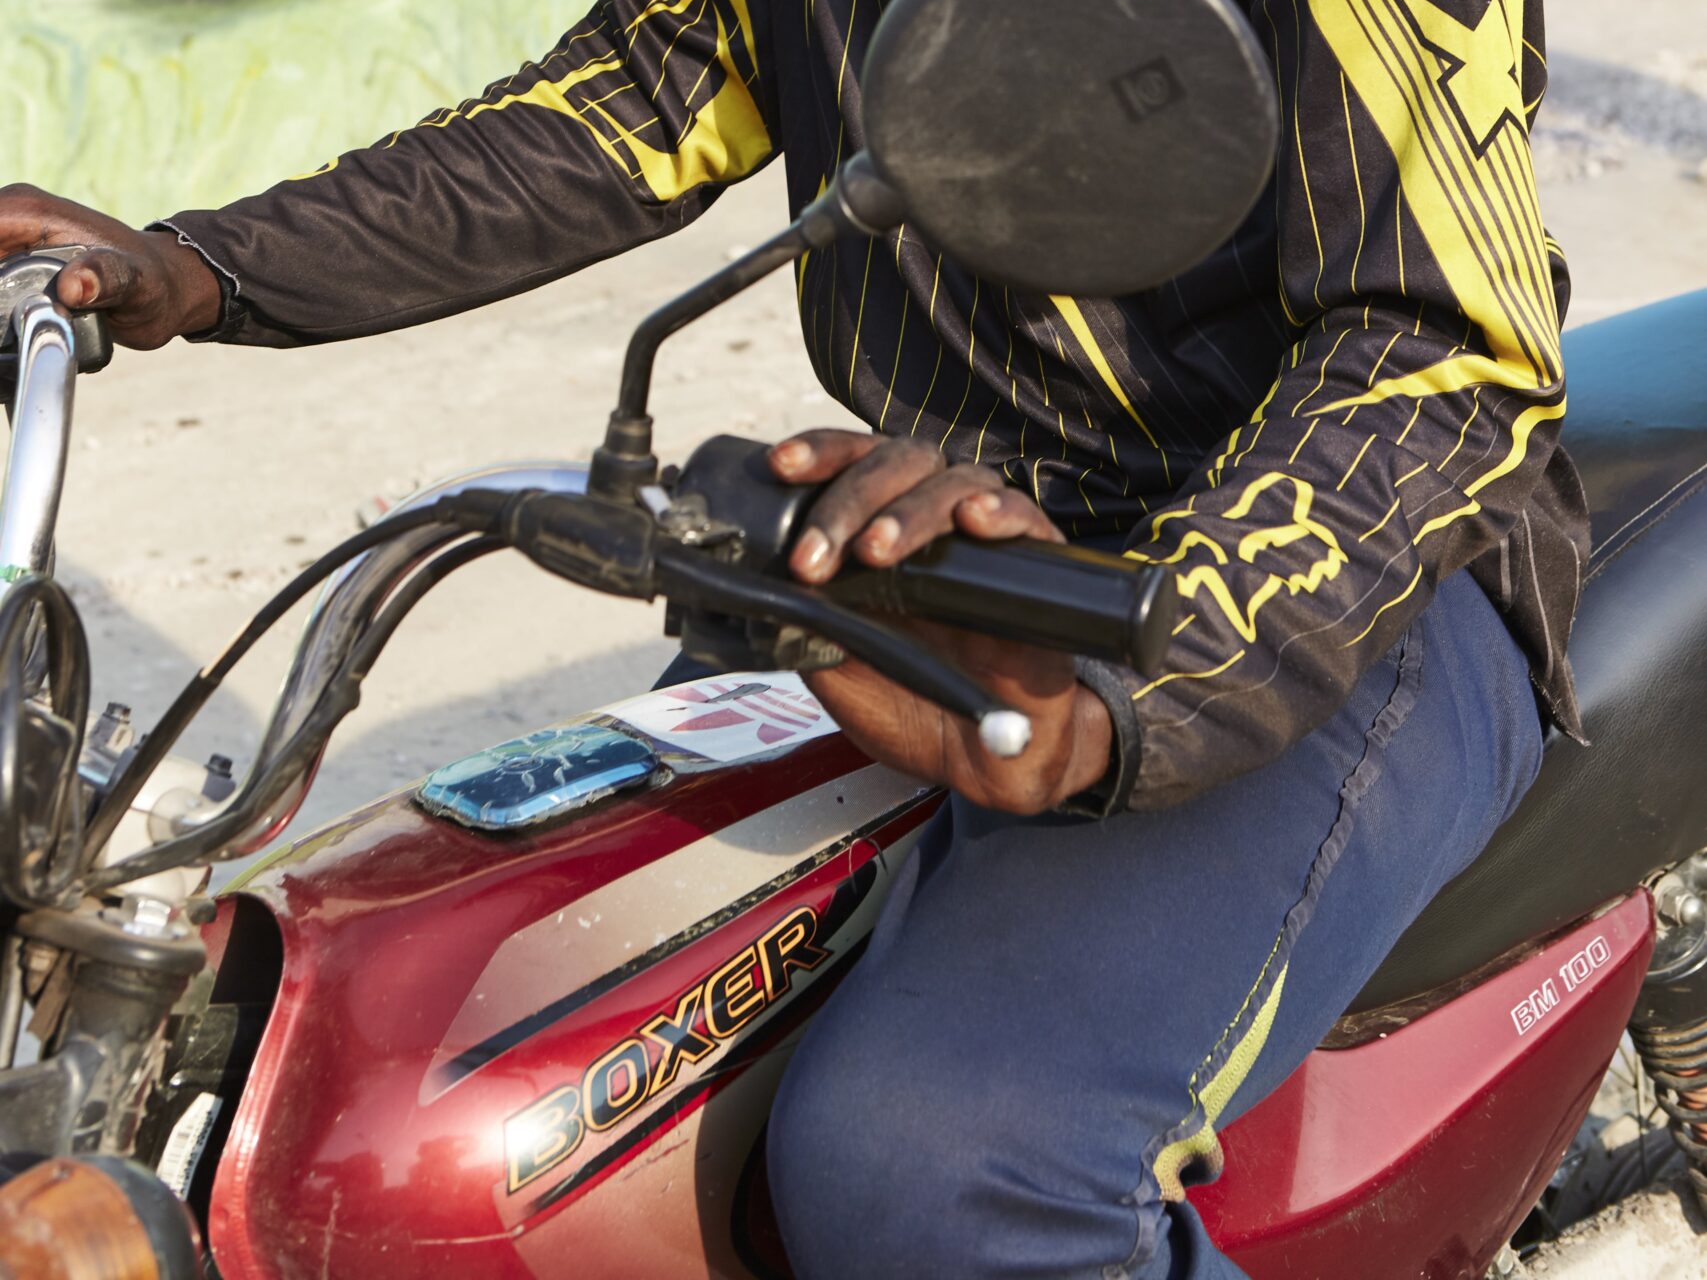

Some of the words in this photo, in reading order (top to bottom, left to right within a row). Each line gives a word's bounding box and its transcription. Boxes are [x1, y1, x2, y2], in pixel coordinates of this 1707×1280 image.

[505, 905, 834, 1195] BOXER
[1510, 978, 1560, 1036] BM
[1559, 935, 1612, 992] 100
